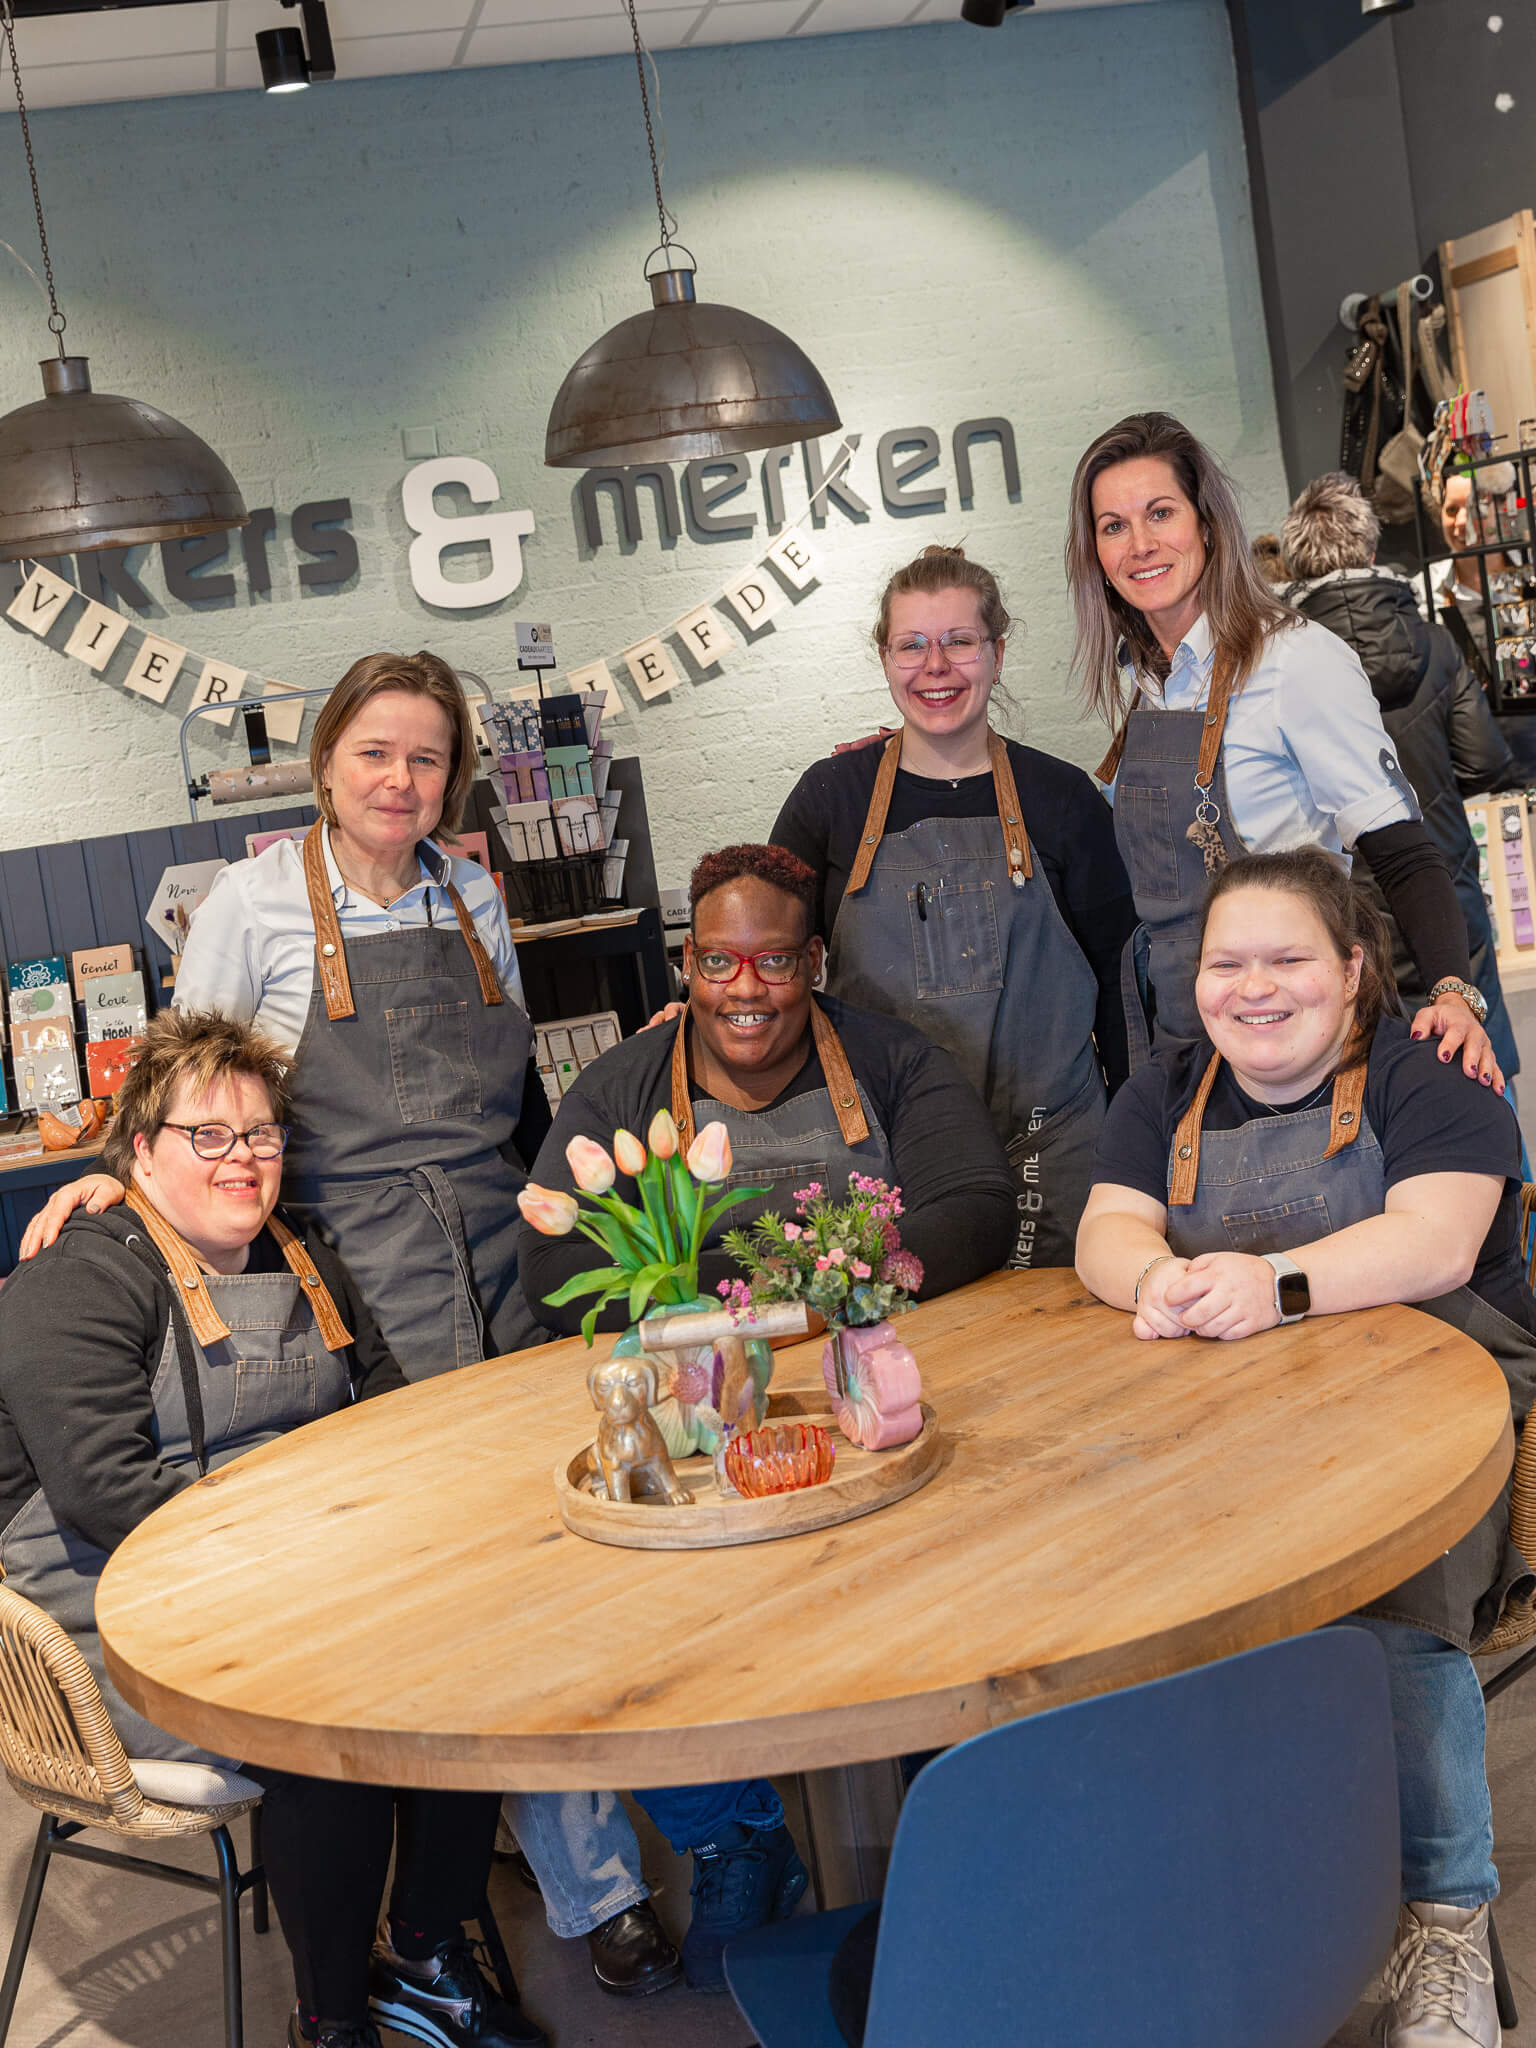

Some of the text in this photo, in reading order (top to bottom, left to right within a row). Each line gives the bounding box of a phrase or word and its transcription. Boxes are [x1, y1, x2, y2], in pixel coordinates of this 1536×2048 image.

[0, 417, 1021, 614] kers & merken
[32, 582, 229, 704] VIER
[1016, 1188, 1044, 1214] &
